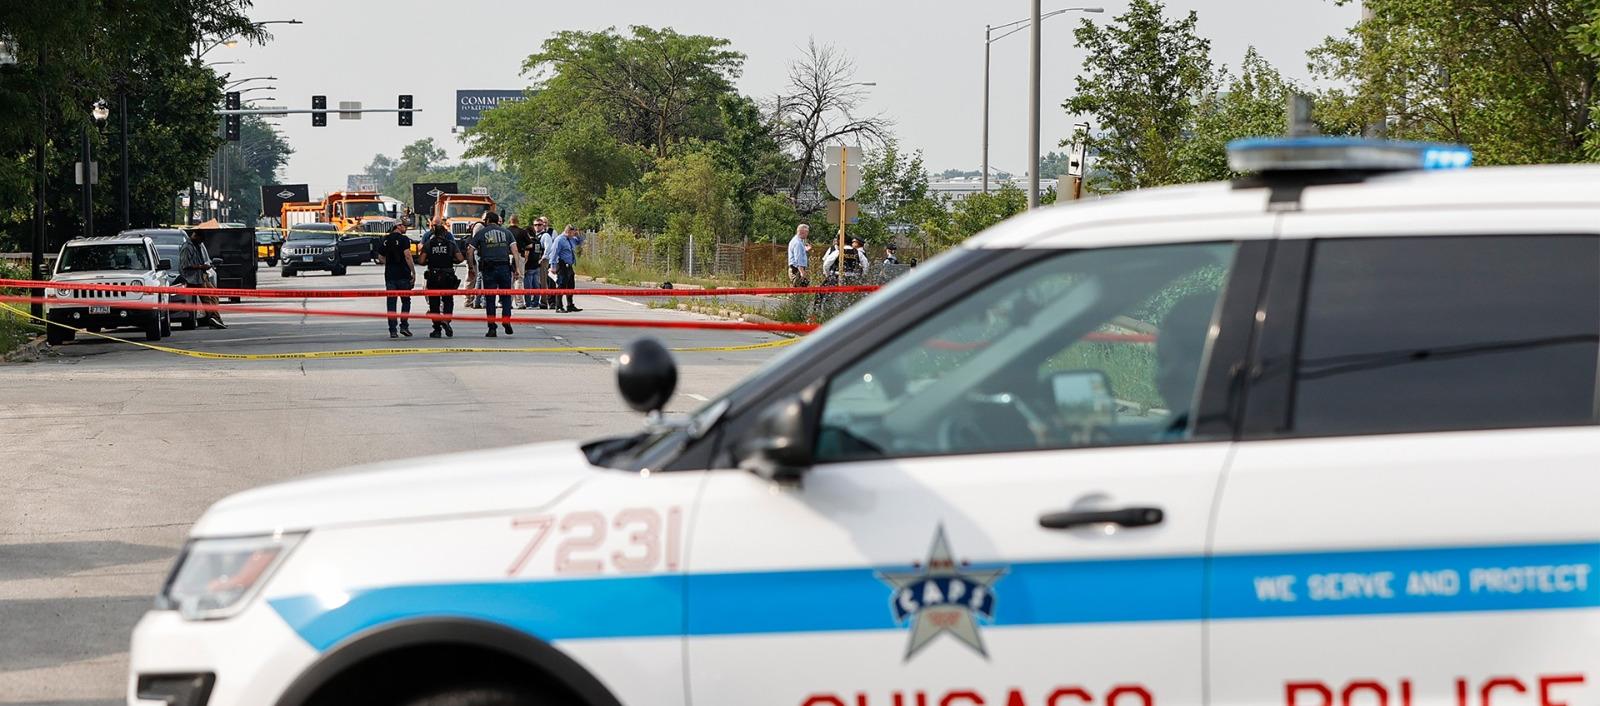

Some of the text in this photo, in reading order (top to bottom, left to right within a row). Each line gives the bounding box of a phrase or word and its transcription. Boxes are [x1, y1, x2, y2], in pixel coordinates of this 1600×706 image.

[432, 246, 447, 254] POLICE
[484, 229, 507, 244] SMITH
[507, 505, 682, 577] 7231
[900, 579, 985, 614] CAPS
[1254, 564, 1591, 601] WE SERVE AND PROTECT
